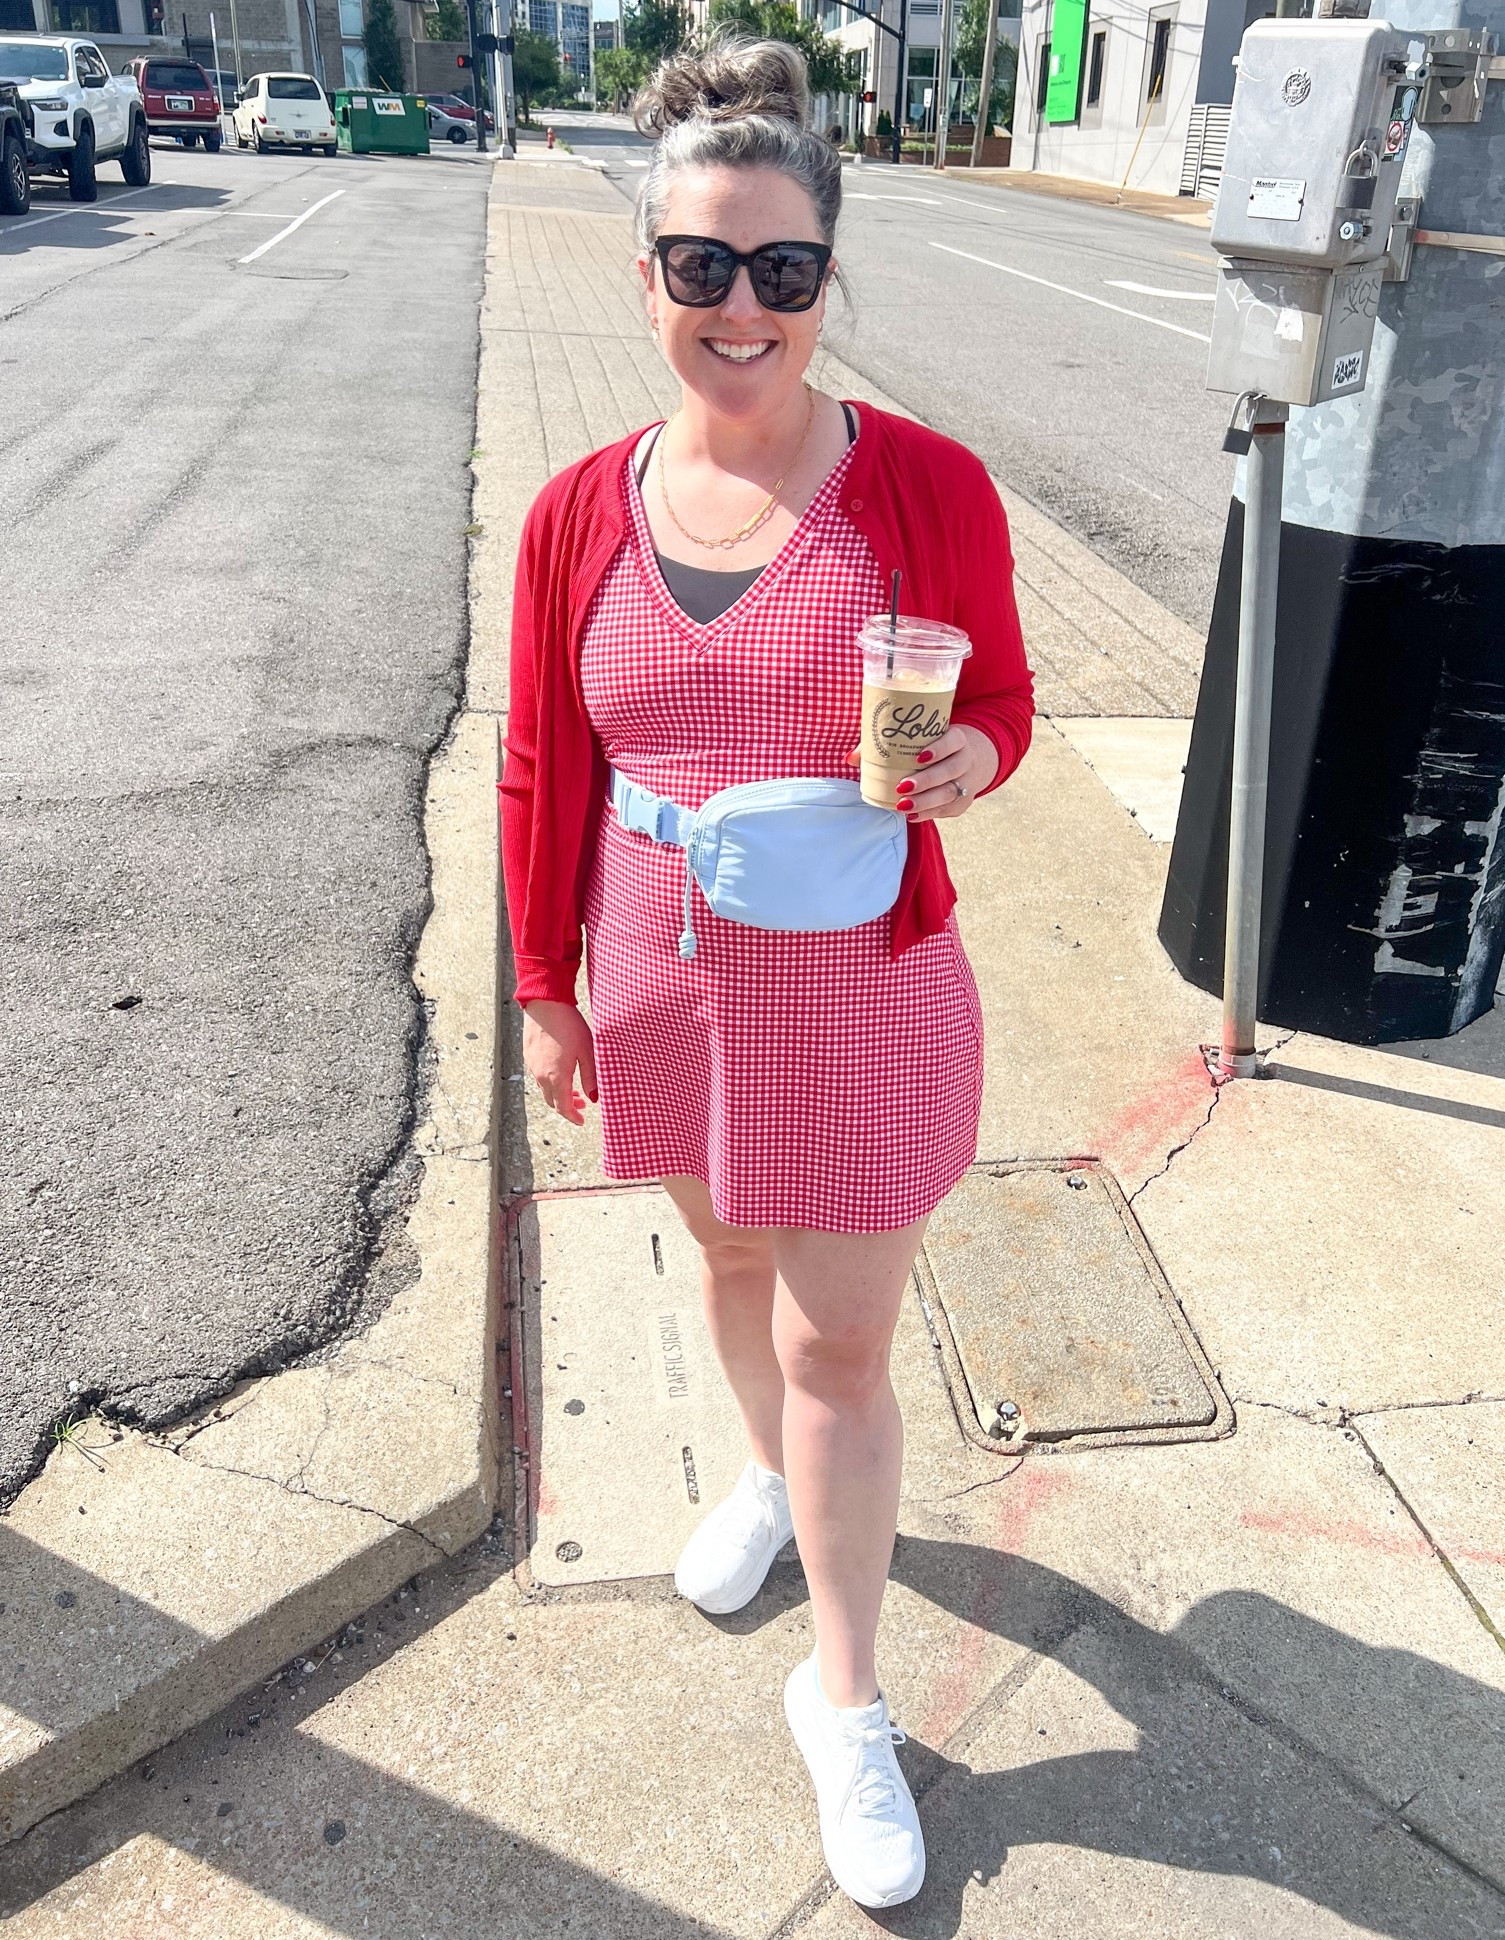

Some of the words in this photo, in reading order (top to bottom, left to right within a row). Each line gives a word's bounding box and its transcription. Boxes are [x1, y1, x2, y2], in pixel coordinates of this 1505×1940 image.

[377, 102, 401, 111] WM
[658, 1312, 682, 1352] SIGNAL
[664, 1353, 689, 1399] TRAFFIC
